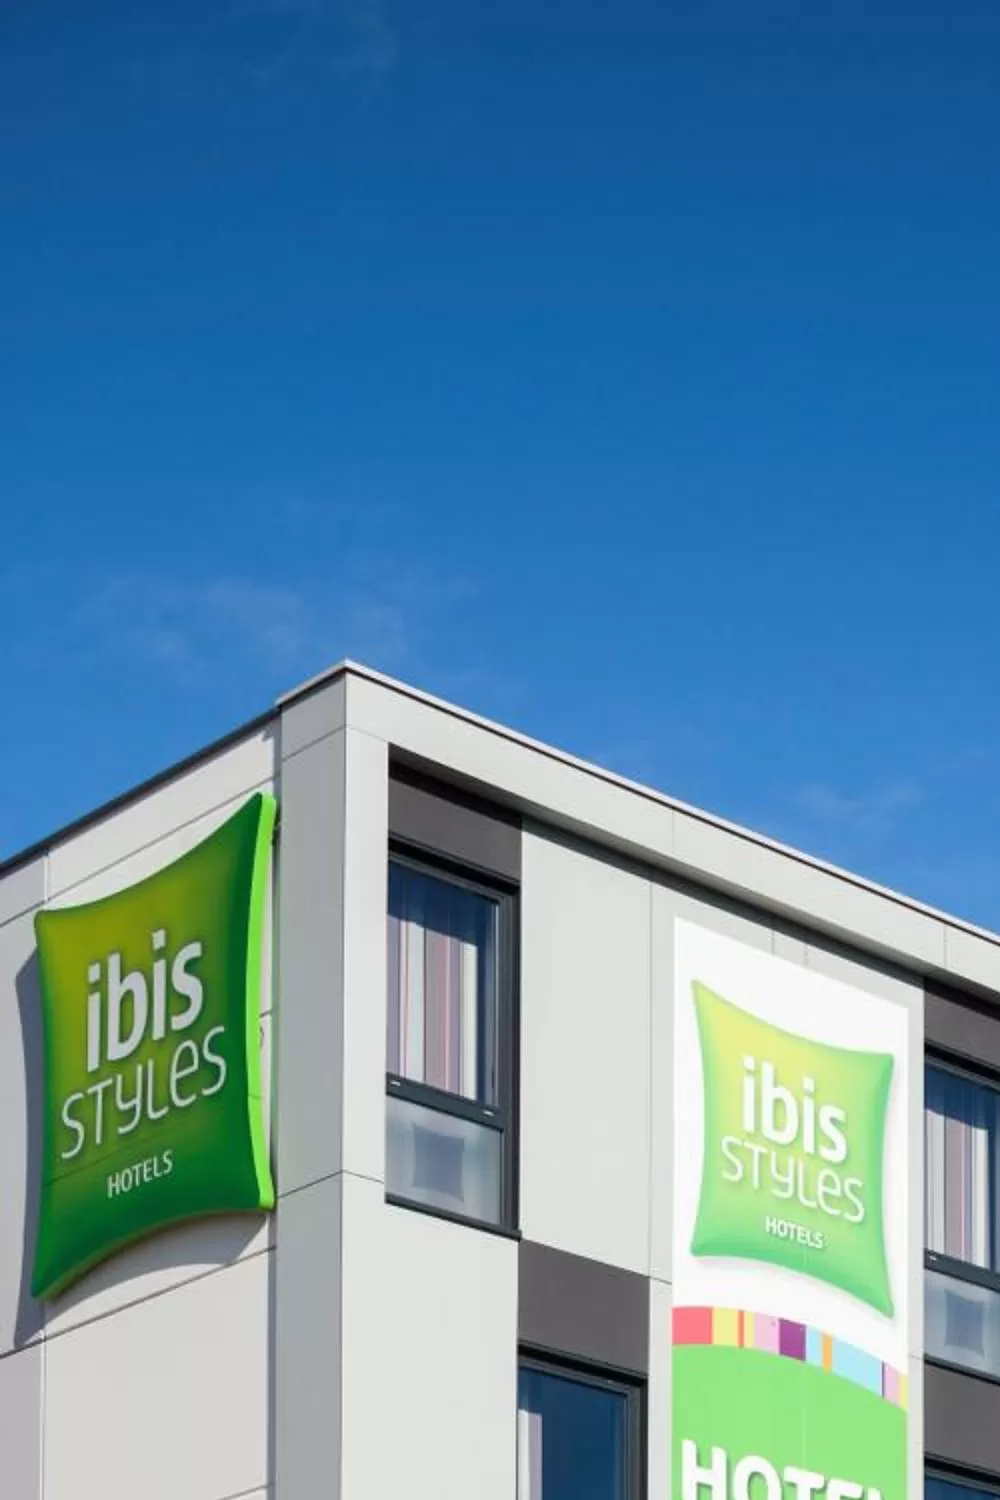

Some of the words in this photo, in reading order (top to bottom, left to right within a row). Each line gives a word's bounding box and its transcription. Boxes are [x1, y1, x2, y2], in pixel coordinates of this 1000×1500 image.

[86, 928, 205, 1073] ibis
[742, 1055, 848, 1164] ibis
[107, 1150, 174, 1199] HOTELS
[765, 1216, 824, 1249] HOTELS
